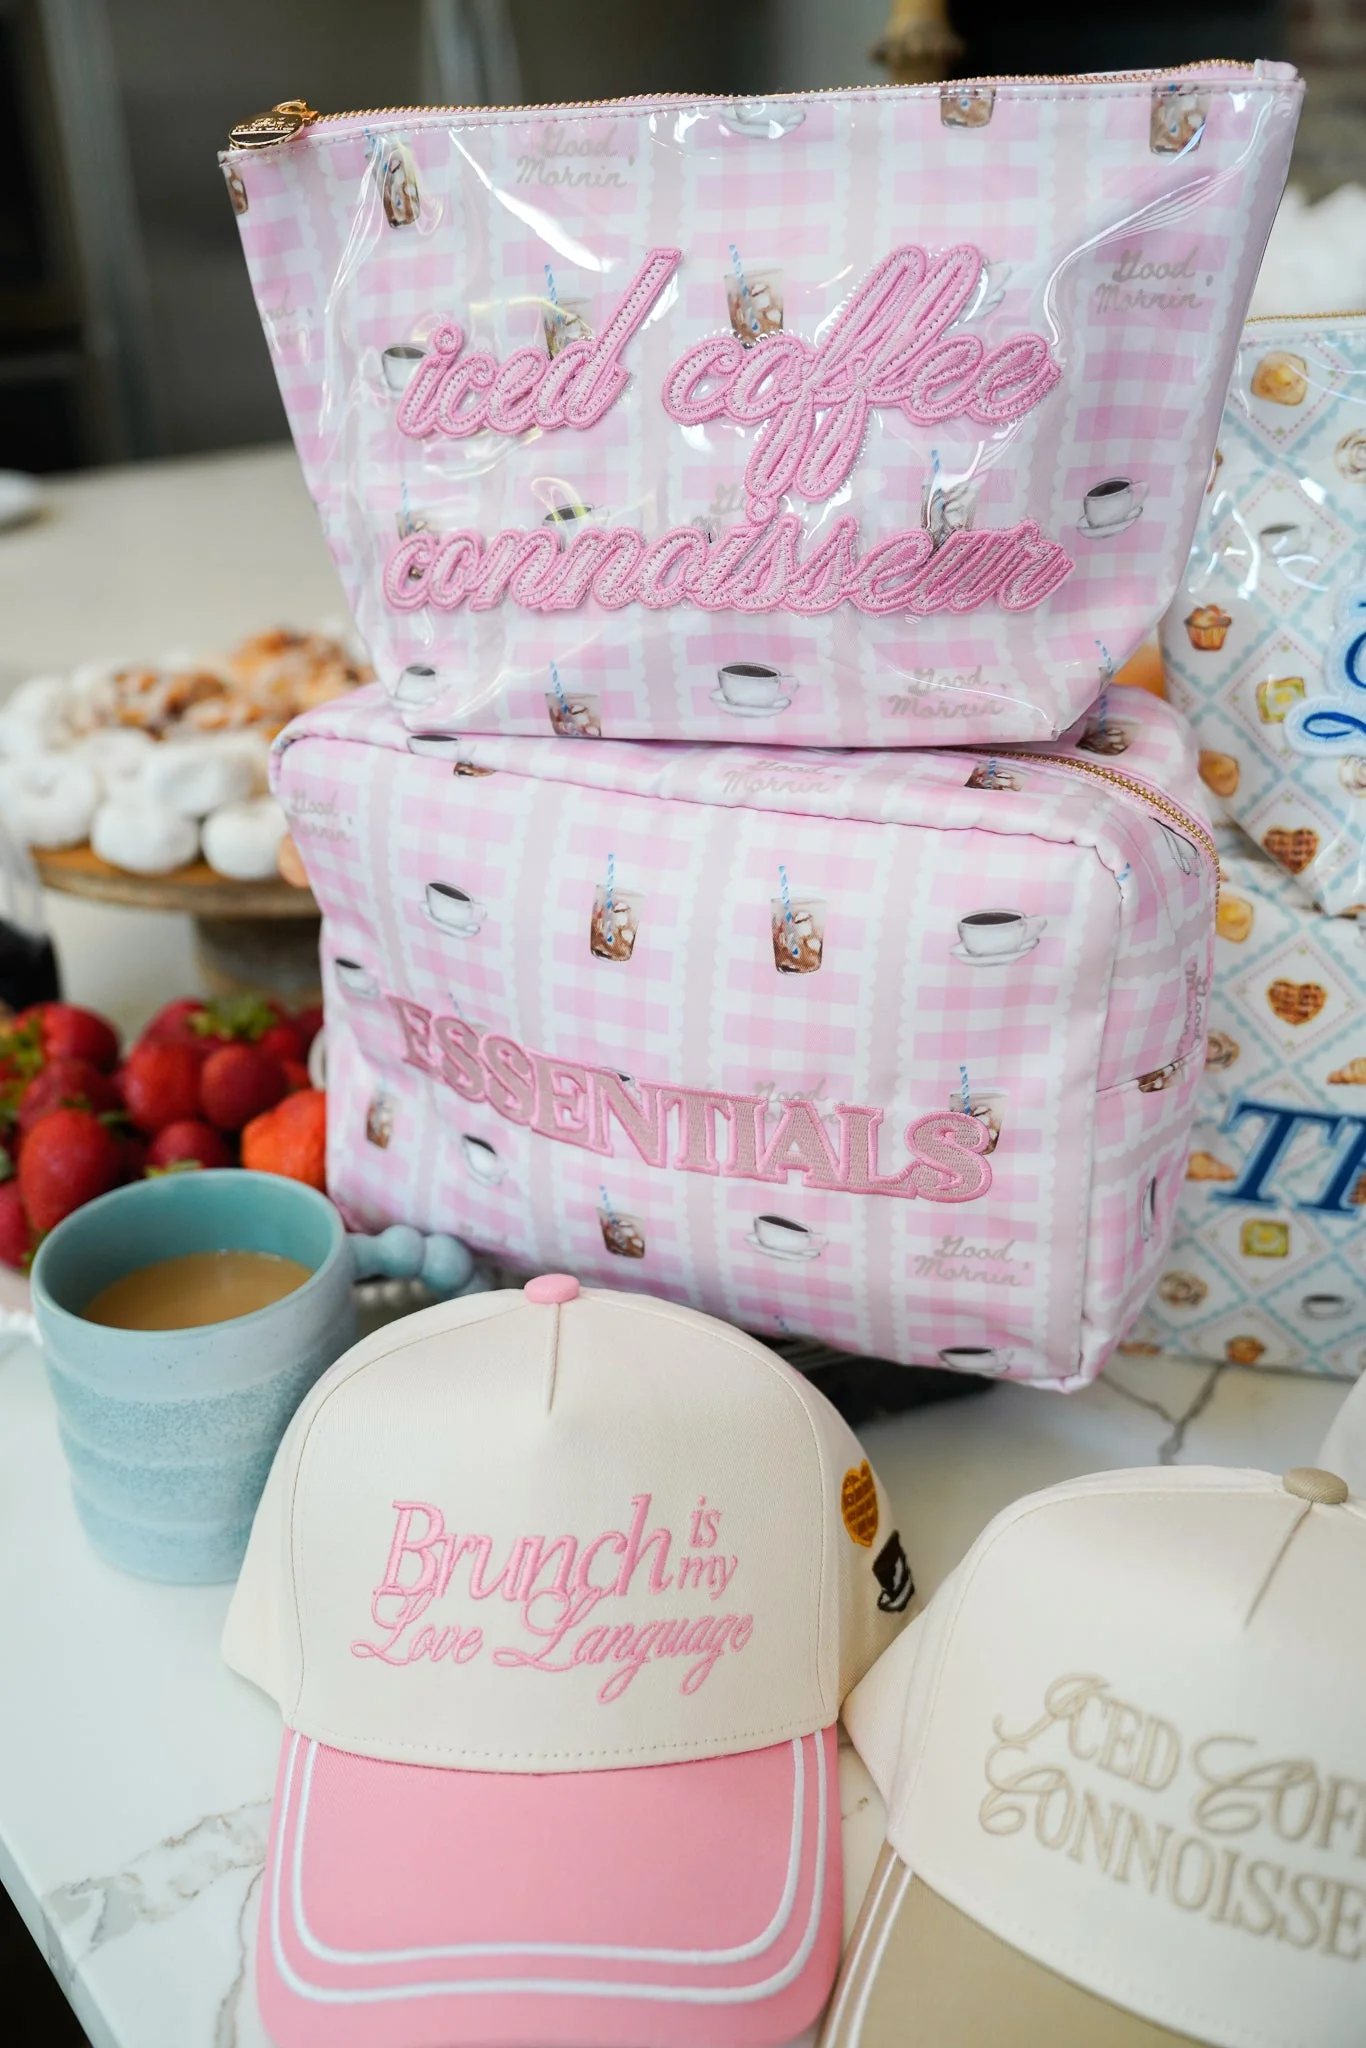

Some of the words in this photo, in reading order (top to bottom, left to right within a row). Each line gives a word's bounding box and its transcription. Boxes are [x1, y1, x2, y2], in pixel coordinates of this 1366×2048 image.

[537, 122, 618, 158] Good
[1111, 245, 1197, 283] Good
[397, 247, 682, 439] iced
[662, 243, 1065, 502] coffee
[382, 494, 1075, 614] connoisseur
[385, 991, 993, 1204] ESSENTIALS
[934, 1235, 1016, 1263] Good
[373, 1493, 674, 1601] Brunch
[687, 1496, 723, 1549] is
[678, 1552, 739, 1600] my
[350, 1585, 484, 1666] Love
[491, 1585, 754, 1704] Language
